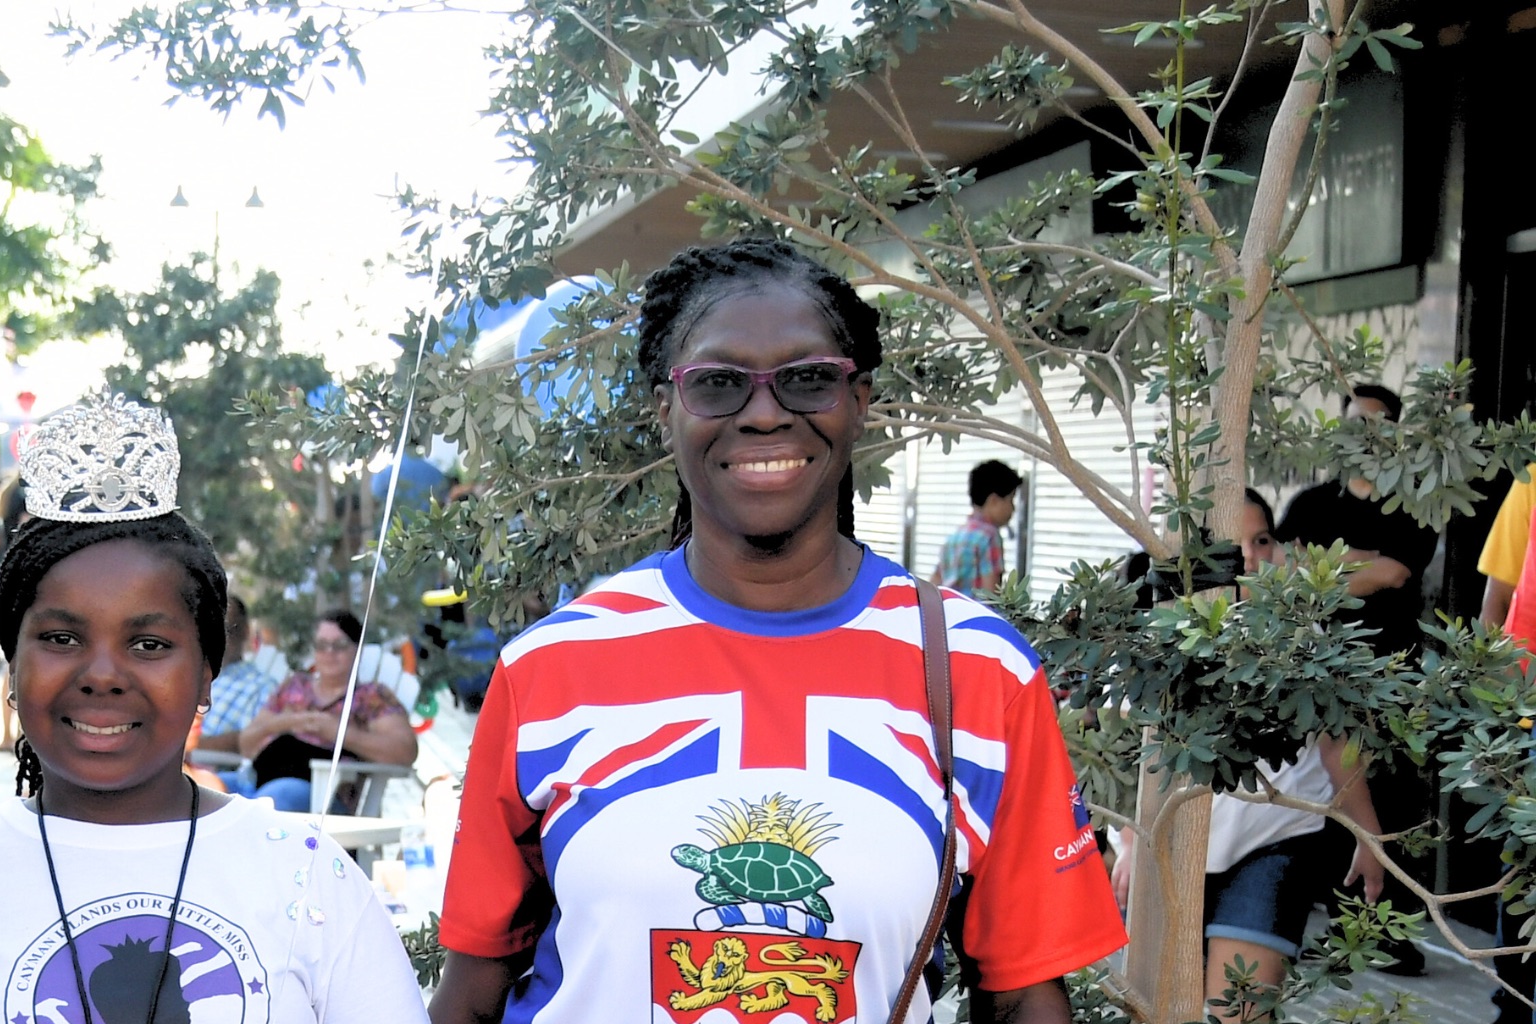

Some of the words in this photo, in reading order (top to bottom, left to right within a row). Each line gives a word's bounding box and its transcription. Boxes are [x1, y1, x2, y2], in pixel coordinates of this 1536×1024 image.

[16, 937, 56, 992] CAYMAN
[126, 898, 163, 910] OUR
[221, 930, 250, 962] MISS
